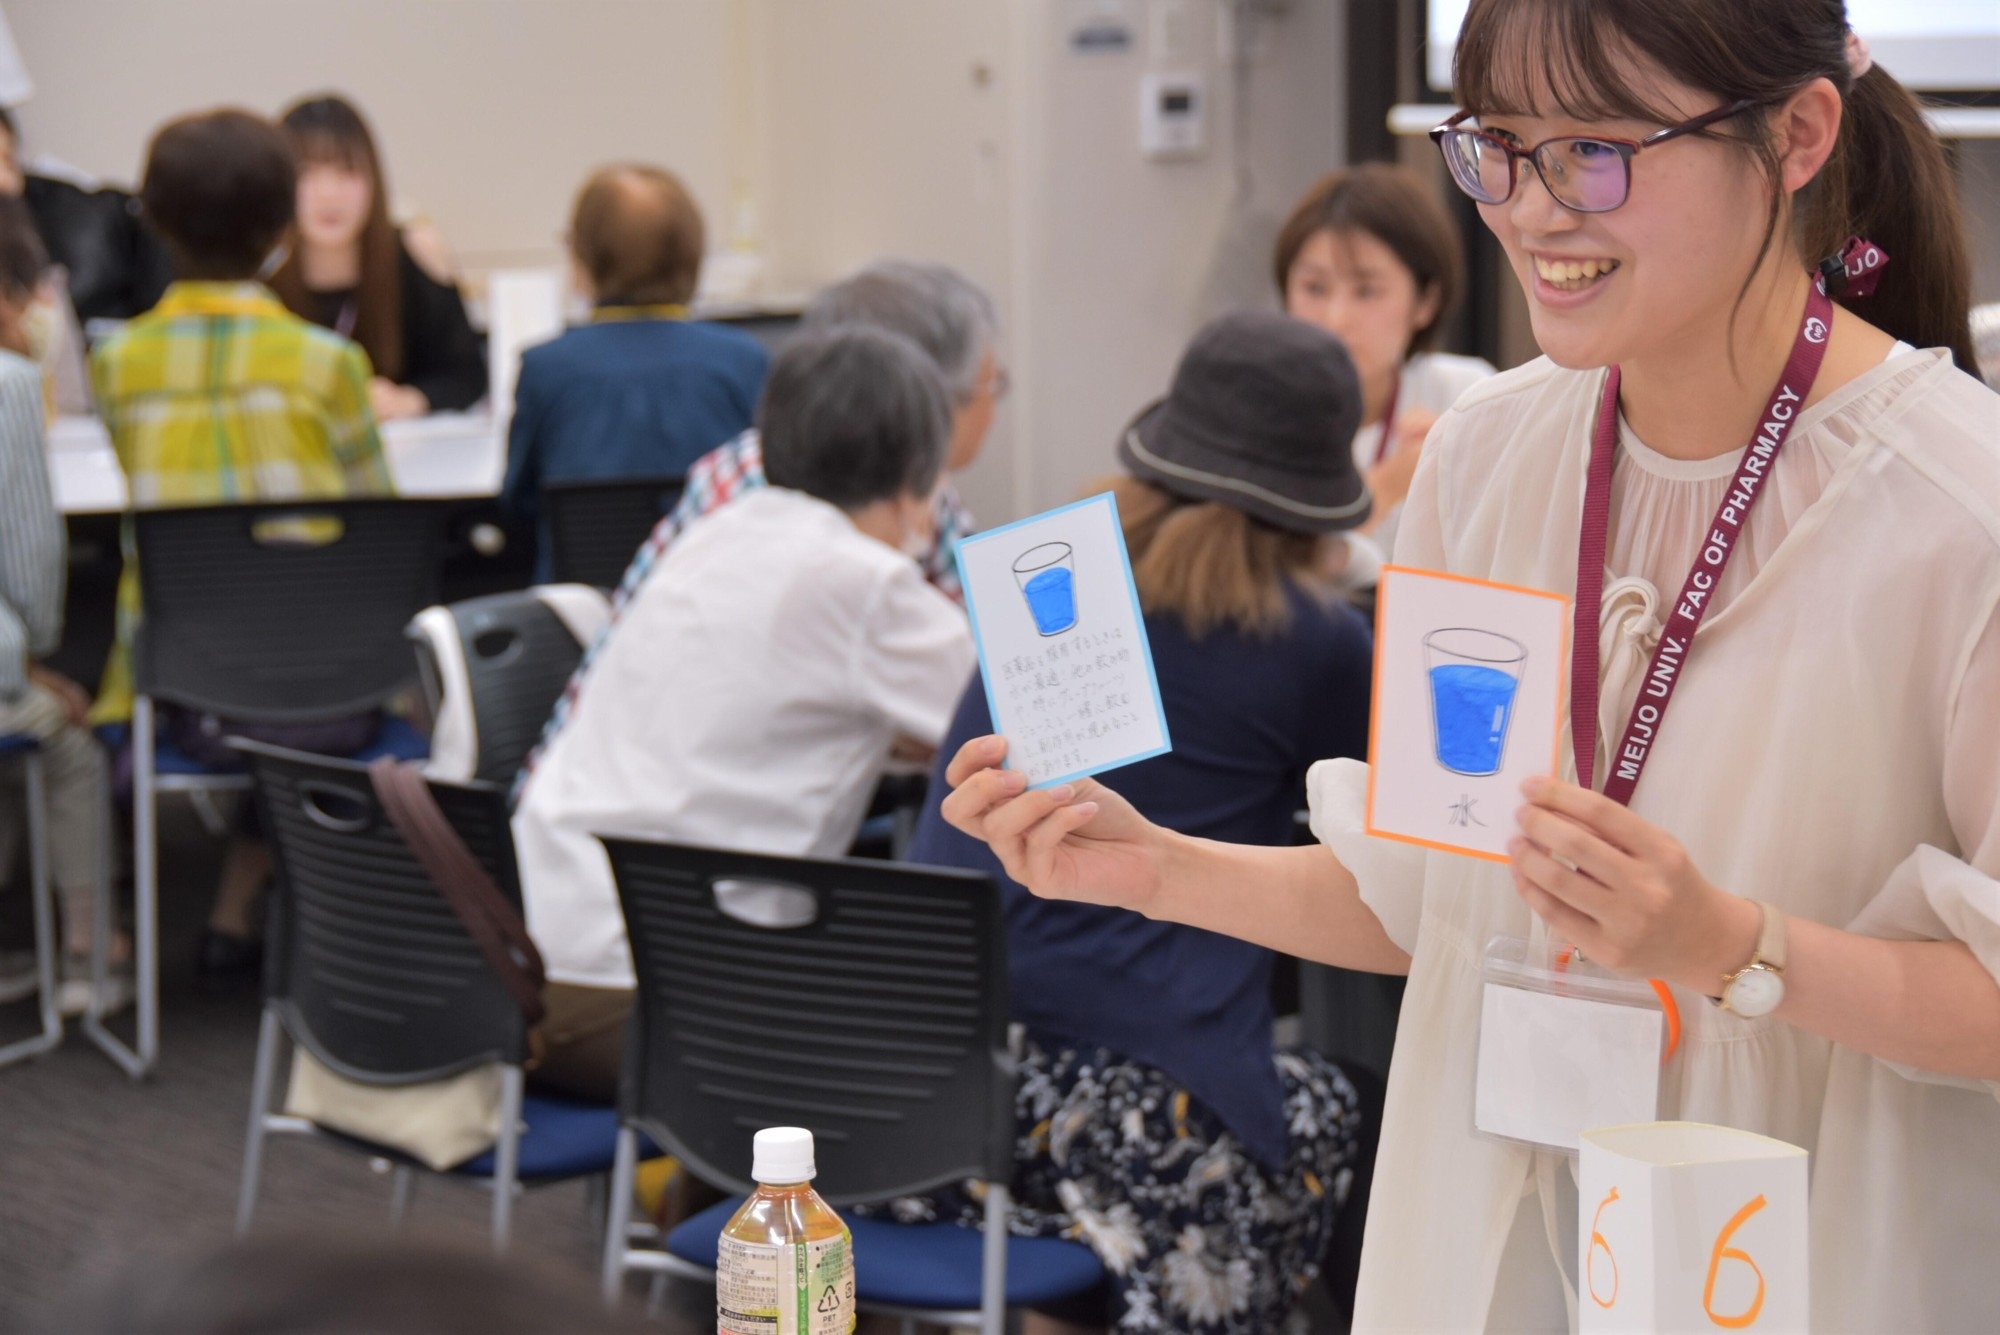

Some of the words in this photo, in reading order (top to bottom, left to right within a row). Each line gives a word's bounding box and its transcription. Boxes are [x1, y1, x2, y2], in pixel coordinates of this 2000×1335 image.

[1616, 704, 1659, 781] MEIJO
[1646, 636, 1687, 698] UNIV.
[1677, 571, 1713, 621] FAC
[1704, 529, 1729, 565] OF
[1720, 384, 1801, 526] PHARMACY
[1447, 793, 1489, 828] 水
[1587, 1185, 1620, 1309] 6
[1703, 1193, 1767, 1329] 6
[822, 1314, 837, 1323] PET
